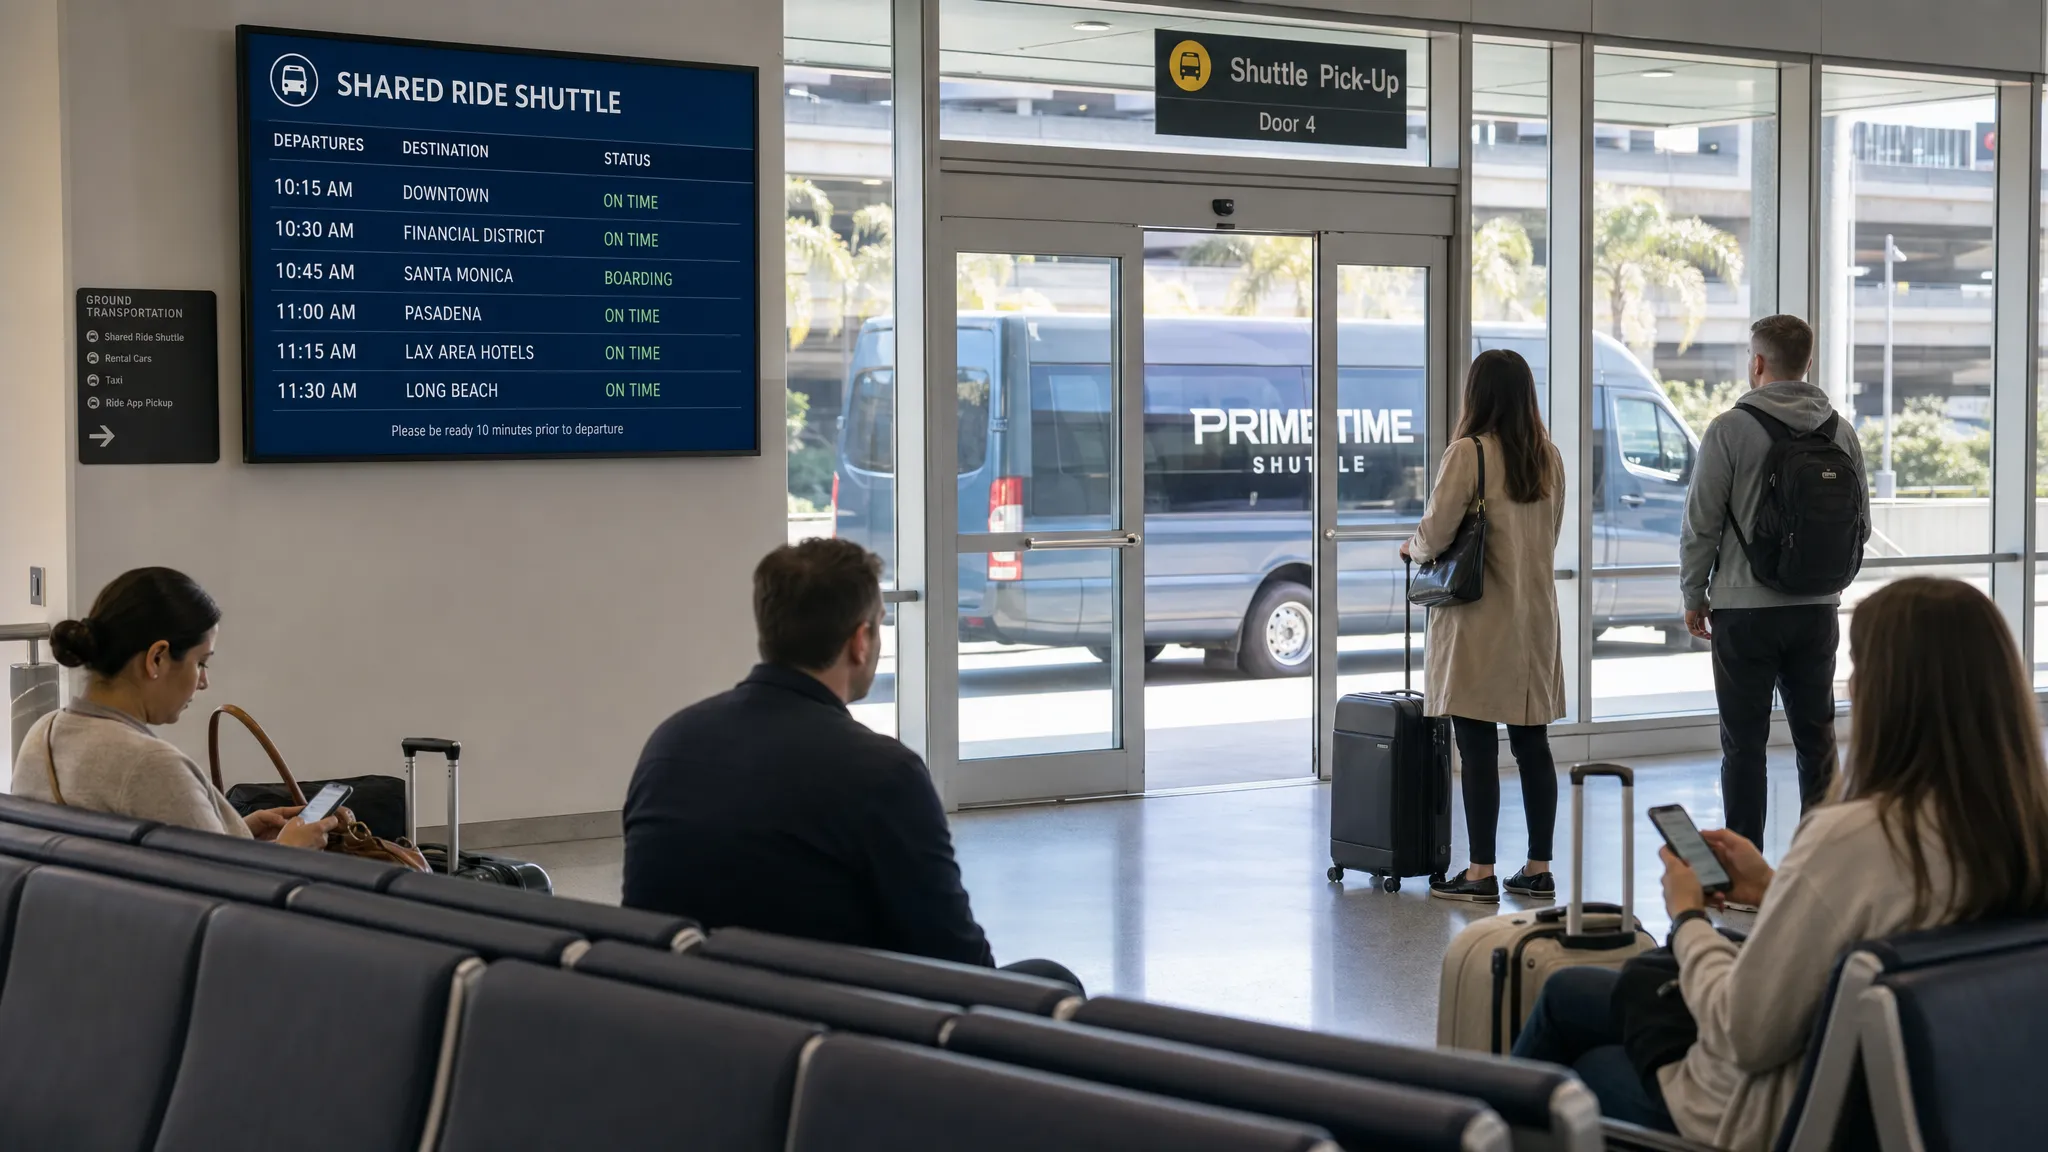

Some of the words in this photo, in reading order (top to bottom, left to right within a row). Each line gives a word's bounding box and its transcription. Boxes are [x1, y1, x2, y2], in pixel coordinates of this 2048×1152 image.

[1230, 56, 1308, 87] Shuttle
[1320, 64, 1400, 99] Pick-Up
[337, 71, 444, 102] SHARED
[452, 80, 508, 107] RIDE
[514, 84, 622, 114] SHUTTLE
[1259, 111, 1300, 133] Door
[1305, 115, 1316, 134] 4
[273, 132, 365, 152] DEPARTURES
[402, 140, 489, 158] DESTINATION
[604, 151, 651, 167] STATUS
[274, 177, 321, 197] 10:15
[326, 180, 353, 198] AM
[403, 184, 489, 203] DOWNTOWN
[603, 193, 623, 208] ON
[626, 194, 659, 210] TIME
[275, 219, 323, 238] 10:30
[327, 221, 354, 239] AM
[404, 224, 480, 242] FINANCIAL
[483, 227, 545, 244] DISTRICT
[604, 231, 624, 247] ON
[627, 232, 659, 248] TIME
[276, 262, 323, 280] 10:45
[328, 263, 355, 280] AM
[404, 265, 453, 282] SANTA
[456, 266, 514, 283] MONICA
[604, 270, 673, 287] BOARDING
[87, 295, 131, 305] GROUND
[87, 308, 182, 318] TRANSPORTATION
[276, 302, 324, 320] 11:00
[329, 303, 356, 320] AM
[405, 305, 482, 322] PASADENA
[604, 307, 624, 323] ON
[628, 308, 660, 324] TIME
[105, 333, 133, 341] Shared
[136, 333, 153, 341] Ride
[156, 333, 184, 341] Shuttle
[105, 354, 130, 362] Rental
[277, 342, 324, 360] 11:15
[329, 343, 356, 360] AM
[405, 343, 434, 360] LAX
[438, 344, 477, 360] AREA
[481, 344, 535, 360] HOTELS
[605, 345, 625, 361] ON
[628, 345, 661, 361] TIME
[106, 376, 122, 384] Taxi
[278, 382, 326, 399] 11:30
[330, 382, 357, 399] AM
[406, 382, 446, 398] LONG
[451, 382, 498, 398] BEACH
[605, 382, 625, 398] ON
[628, 382, 661, 397] TIME
[106, 398, 124, 407] Ride
[127, 399, 143, 408] App
[146, 399, 173, 408] Pickup
[392, 425, 425, 436] Please
[429, 425, 441, 436] be
[445, 424, 473, 439] ready
[477, 425, 489, 436] 10
[492, 424, 532, 436] minutes
[536, 424, 559, 438] prior
[562, 424, 572, 435] to
[575, 423, 624, 437] departure
[1337, 408, 1414, 444] TIME
[1253, 455, 1365, 474] SHUTLE
